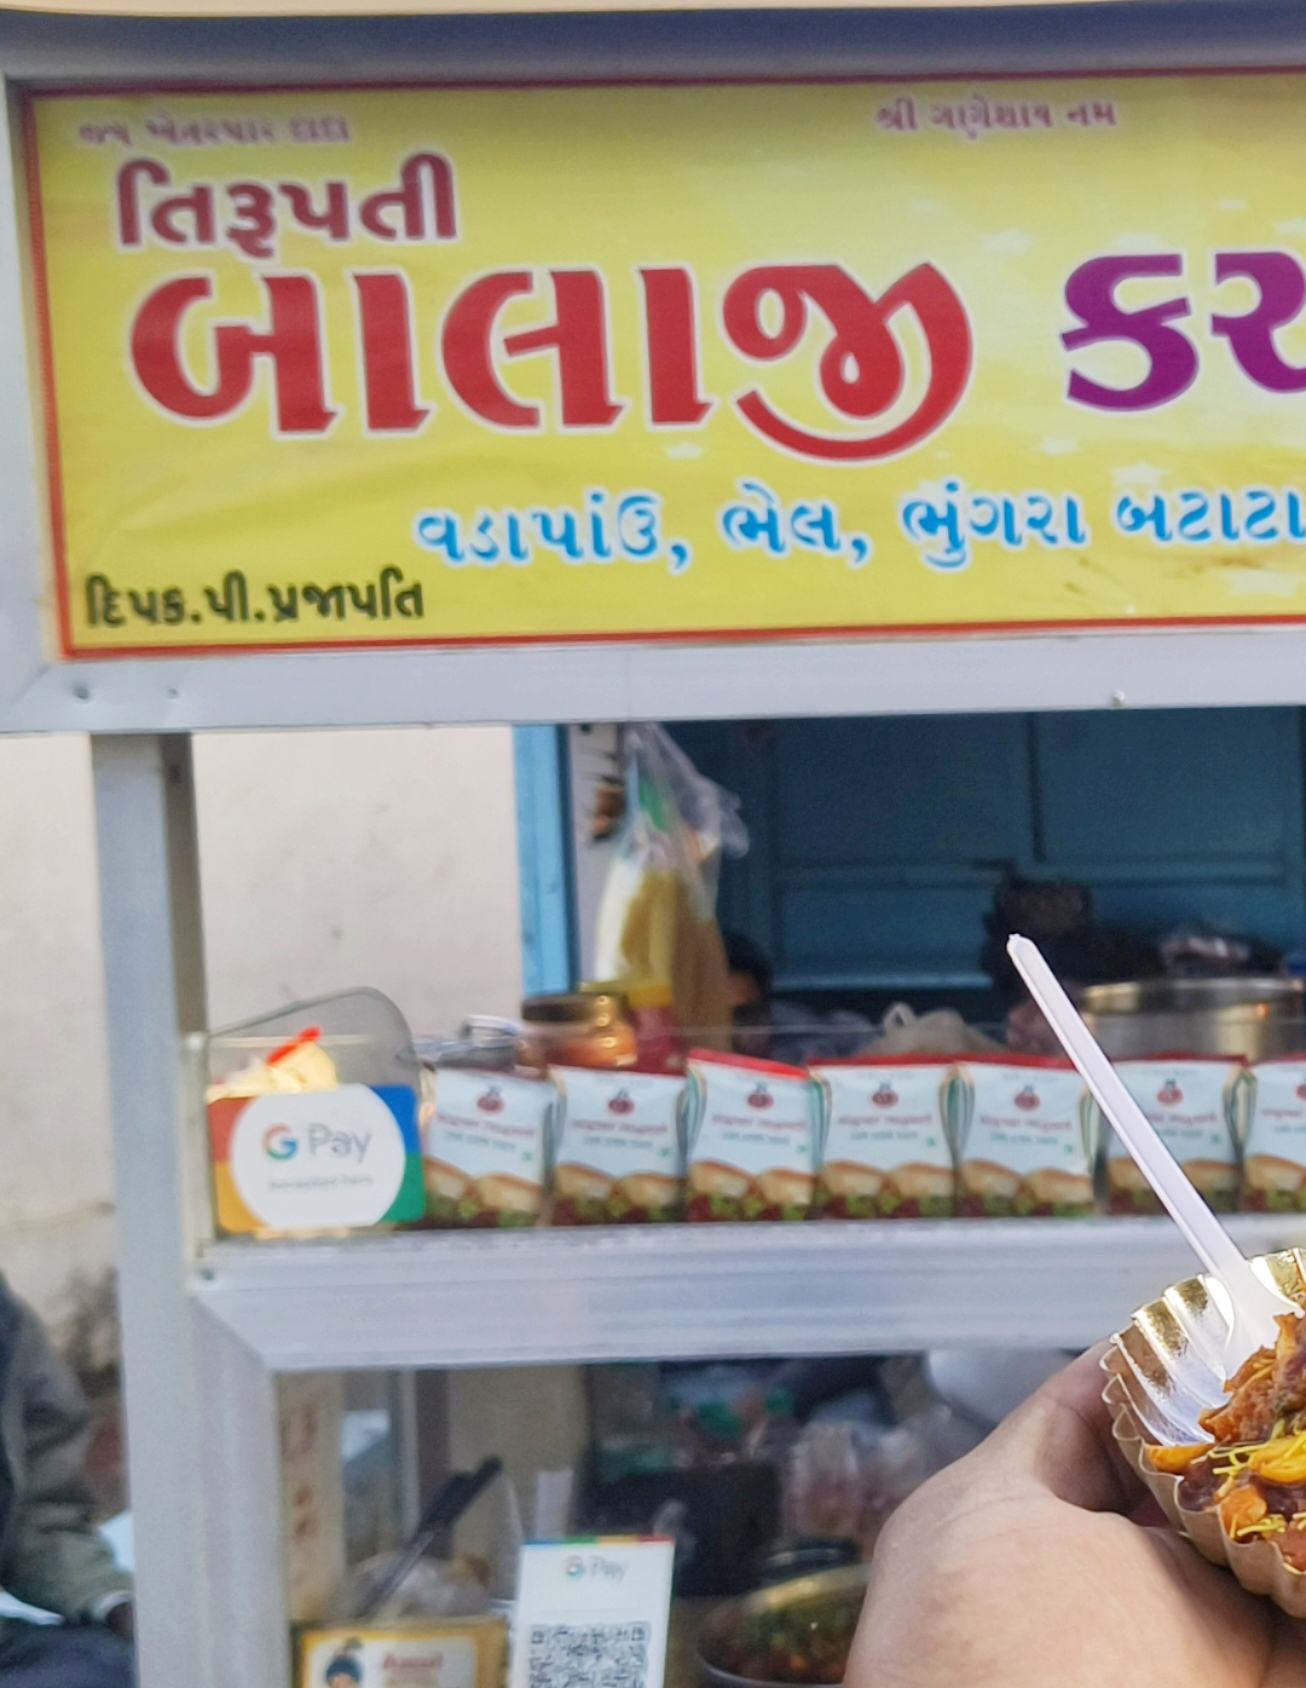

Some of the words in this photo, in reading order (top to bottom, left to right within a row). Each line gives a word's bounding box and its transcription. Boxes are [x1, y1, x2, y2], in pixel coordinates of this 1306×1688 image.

[79, 122, 132, 147] જય
[877, 96, 917, 130] શ્રી
[116, 152, 458, 259] તિરૂપતી
[130, 262, 974, 461] બાલાજી
[418, 492, 690, 570] વડાપાંઉ,
[722, 481, 870, 564] ભેલ,
[902, 481, 1087, 568] ભુંગરા
[262, 1122, 298, 1161] G
[307, 1122, 373, 1165] Pay
[588, 1553, 630, 1585] Pay
